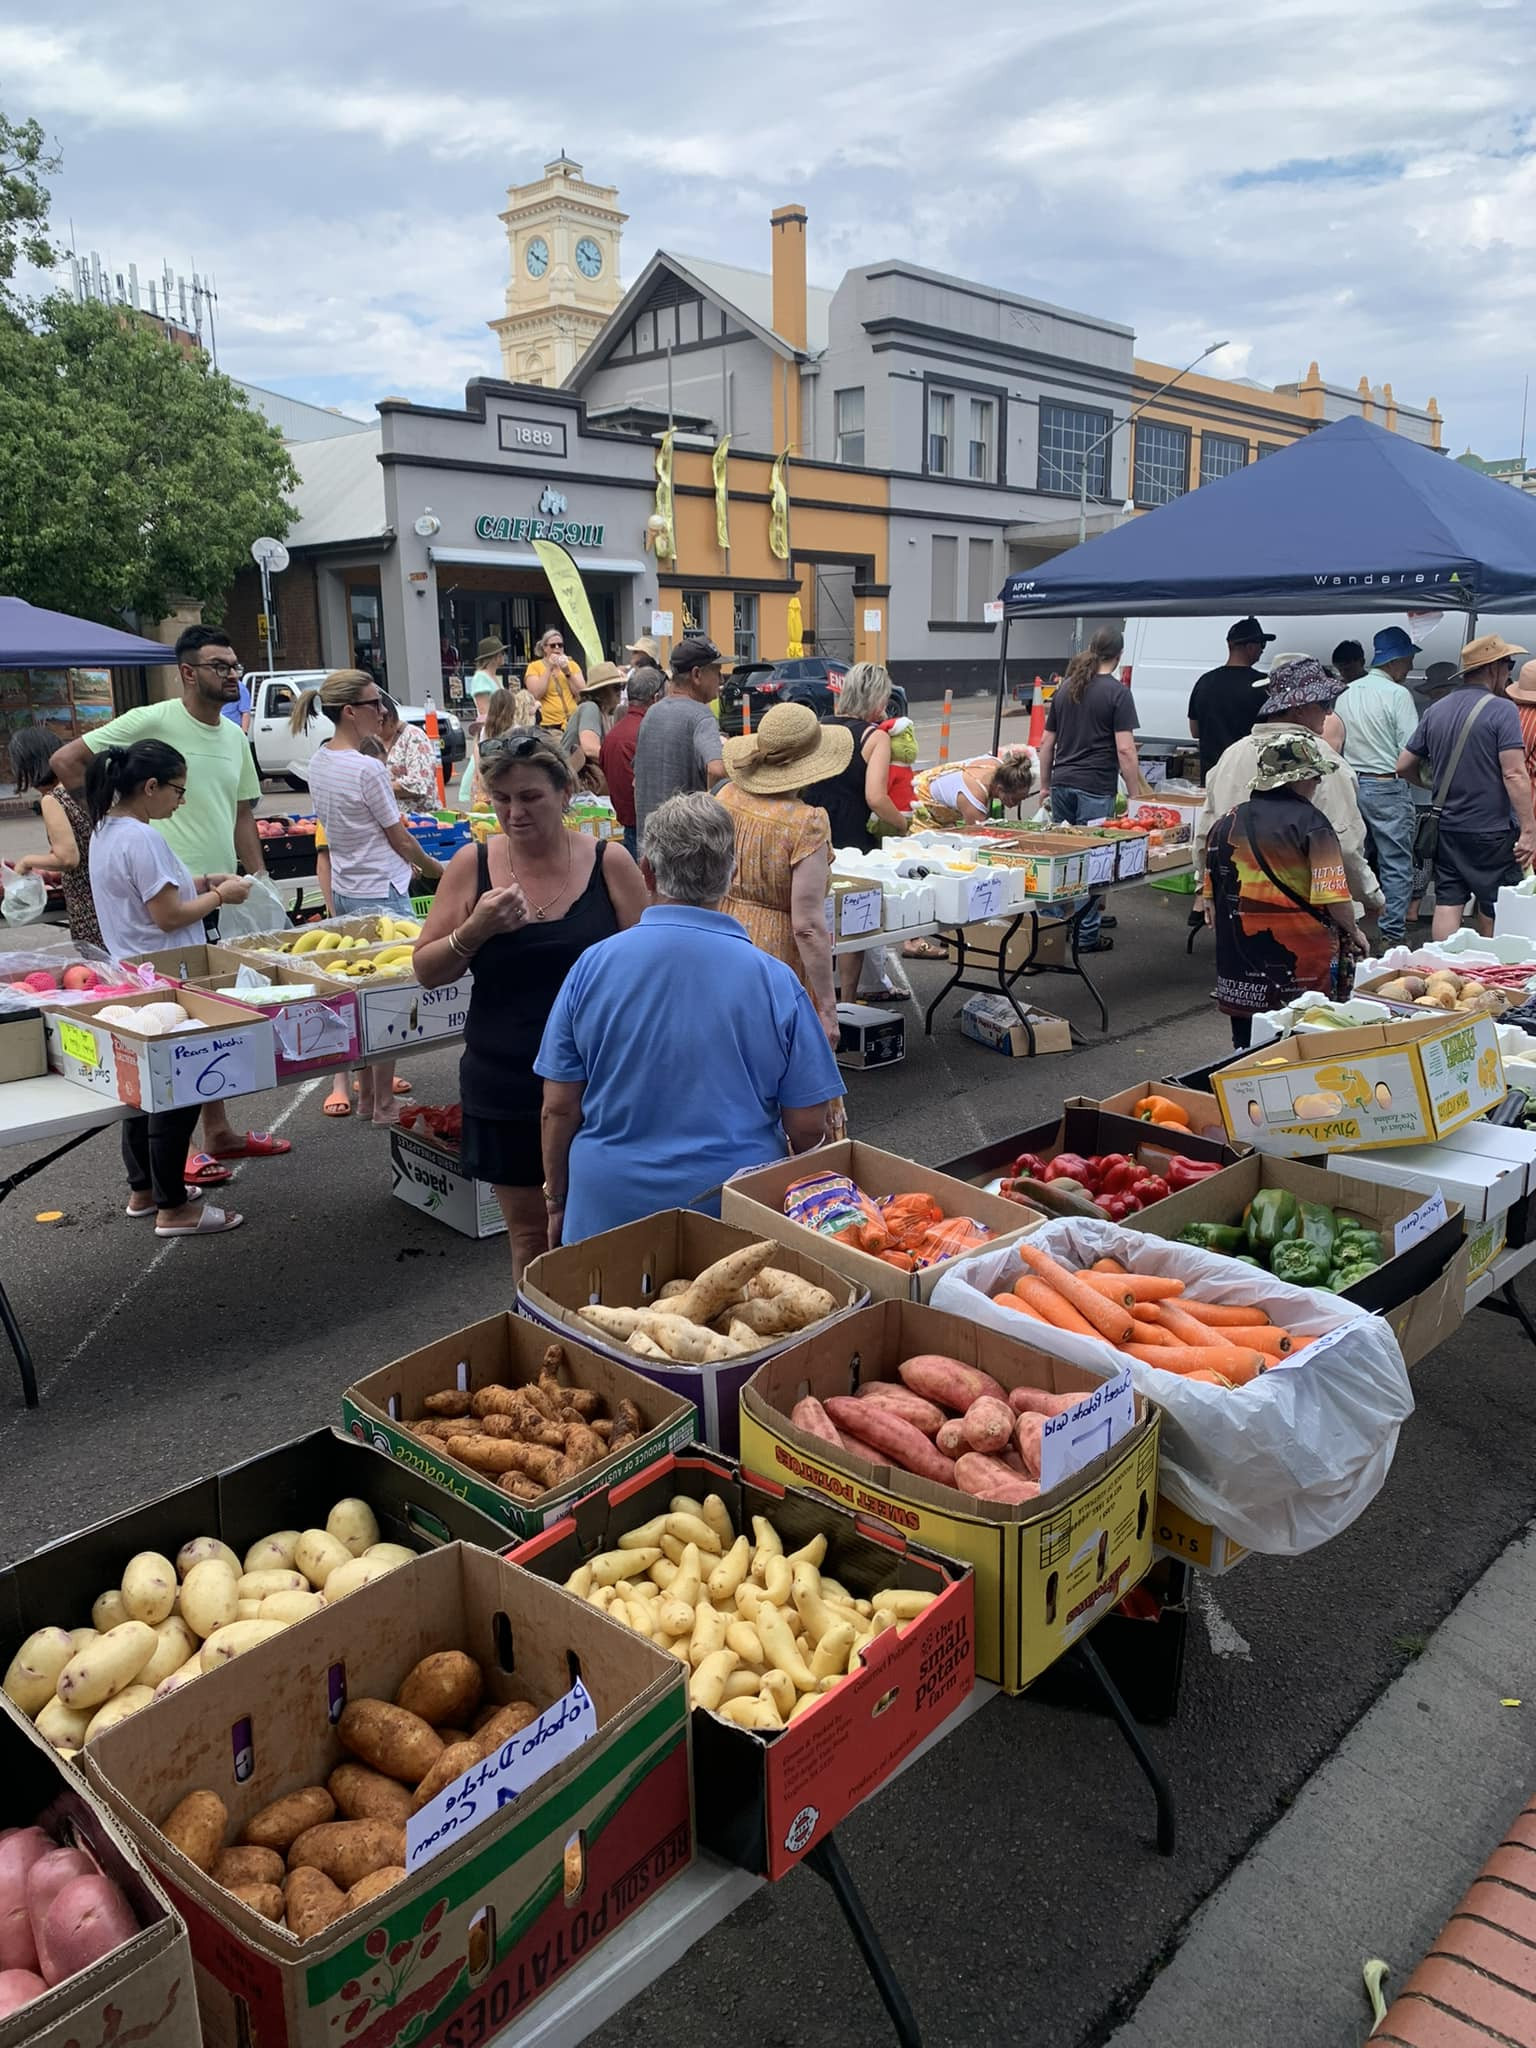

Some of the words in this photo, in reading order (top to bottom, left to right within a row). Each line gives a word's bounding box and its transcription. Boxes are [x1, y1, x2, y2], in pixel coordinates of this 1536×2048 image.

[515, 426, 553, 446] 1889
[476, 513, 546, 541] CAFE
[548, 520, 605, 547] 5911
[1314, 572, 1440, 585] Wanderer
[422, 986, 458, 1006] CLASS
[1239, 981, 1268, 993] BEACH
[175, 1045, 208, 1060] Pears
[213, 1037, 244, 1052] Nashi
[297, 1017, 337, 1055] 12
[196, 1053, 230, 1096] 6
[1374, 1113, 1402, 1123] Zealand
[1389, 1120, 1416, 1132] Product
[1402, 1112, 1418, 1121] New
[413, 1166, 448, 1197] pace
[636, 1438, 668, 1467] PRODUCE
[396, 1446, 469, 1500] Produce
[581, 1466, 622, 1498] AUSTRALIA
[775, 1444, 855, 1503] POTATOES
[857, 1490, 920, 1531] SWEET
[1160, 1526, 1199, 1553] OTS
[936, 1618, 954, 1642] the
[920, 1615, 967, 1681] small
[853, 1660, 887, 1695] Gourmet
[915, 1640, 970, 1712] potato
[929, 1671, 957, 1709] farm
[654, 1829, 689, 1879] RED
[614, 1863, 650, 1915] SOIL
[445, 1892, 609, 2048] POTATOES
